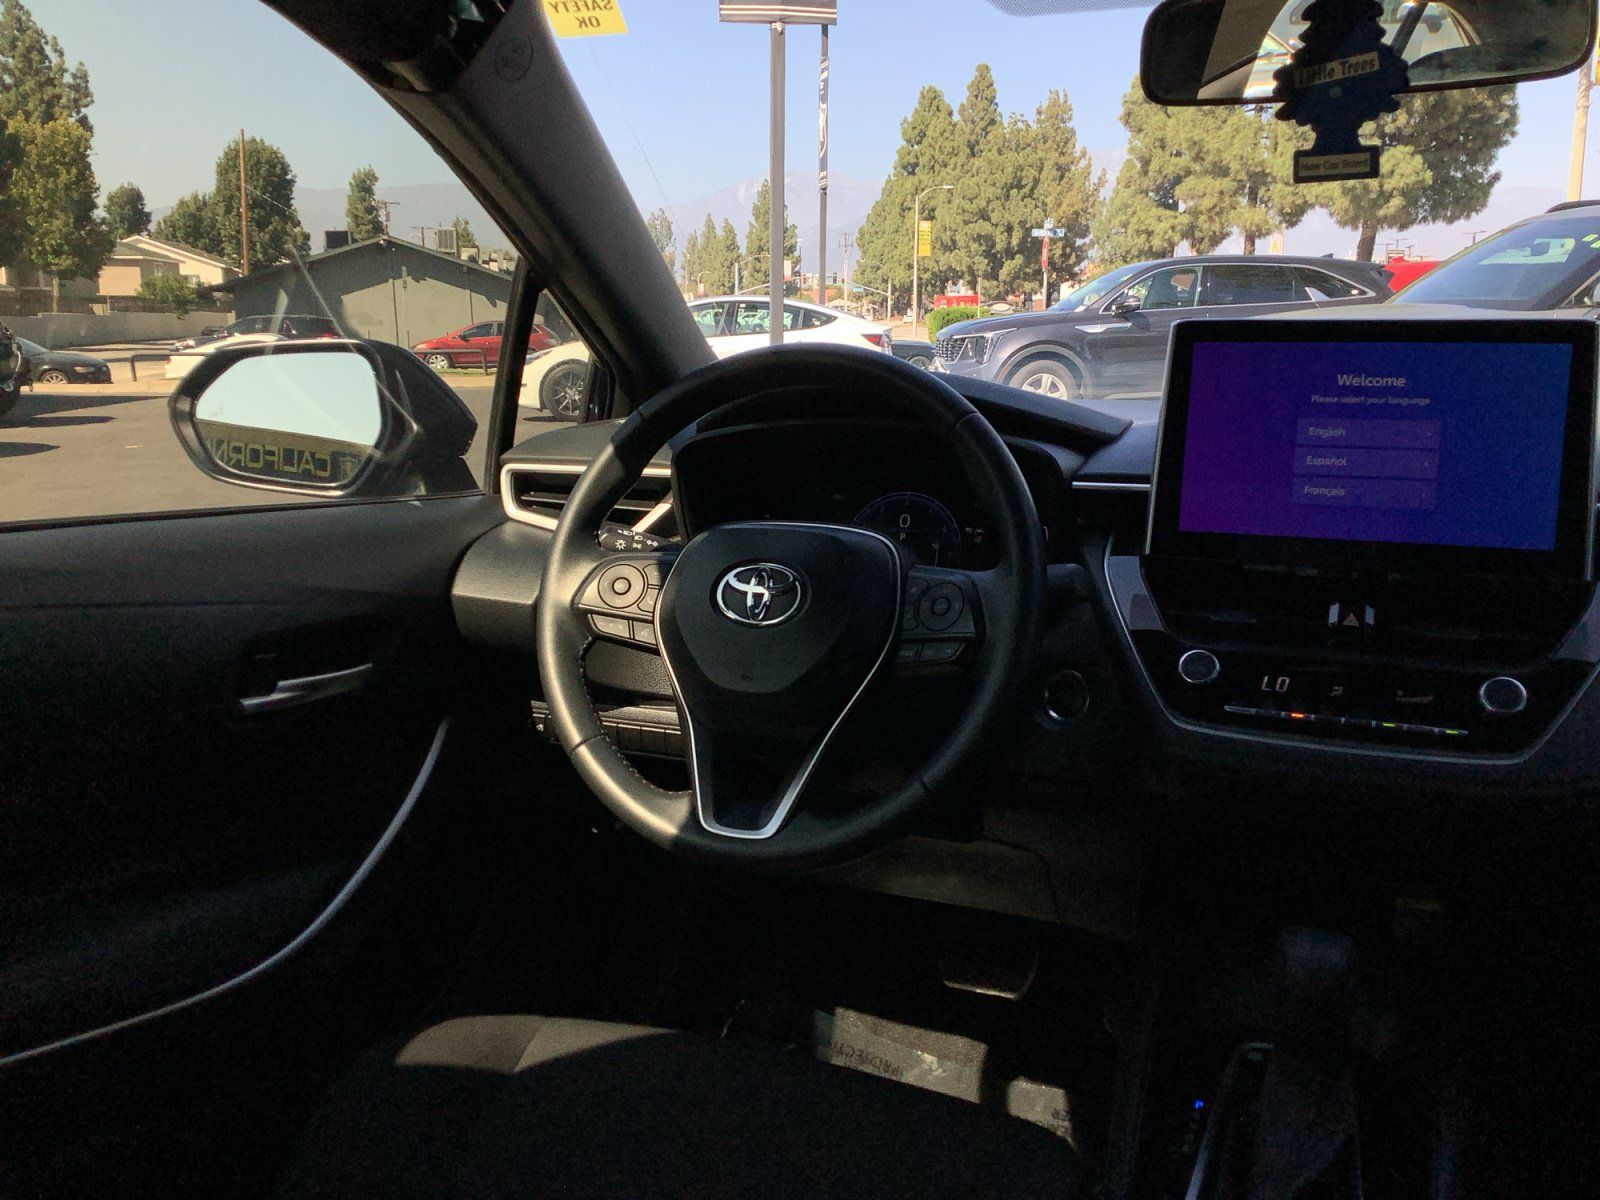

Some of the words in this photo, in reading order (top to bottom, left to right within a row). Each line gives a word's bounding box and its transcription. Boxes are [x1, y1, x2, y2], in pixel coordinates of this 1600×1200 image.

[1337, 374, 1407, 387] Welcome
[1308, 427, 1346, 438] English
[1307, 455, 1347, 467] Español
[1304, 485, 1345, 498] Français
